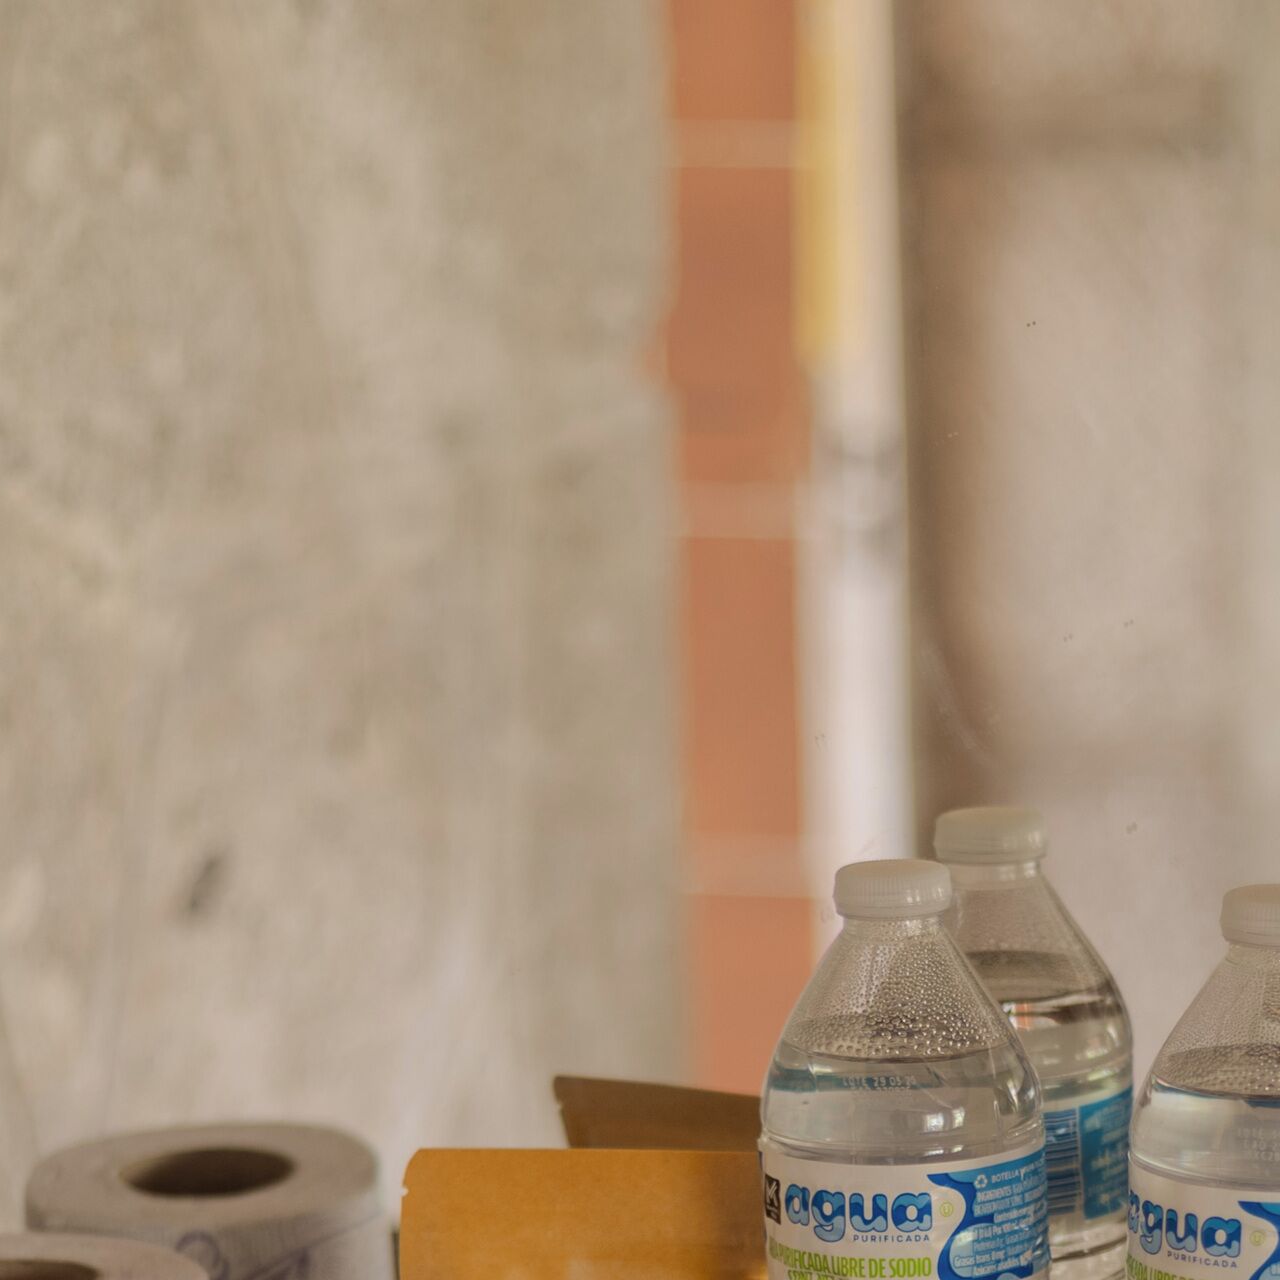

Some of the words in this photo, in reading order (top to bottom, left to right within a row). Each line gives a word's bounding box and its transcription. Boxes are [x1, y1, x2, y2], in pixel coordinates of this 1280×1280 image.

[784, 1183, 933, 1243] agua
[1128, 1189, 1242, 1258] agua
[852, 1234, 931, 1243] PURIFICADA
[868, 1257, 887, 1279] DE
[889, 1257, 932, 1278] SODIO
[1167, 1249, 1238, 1269] PURIFICADA
